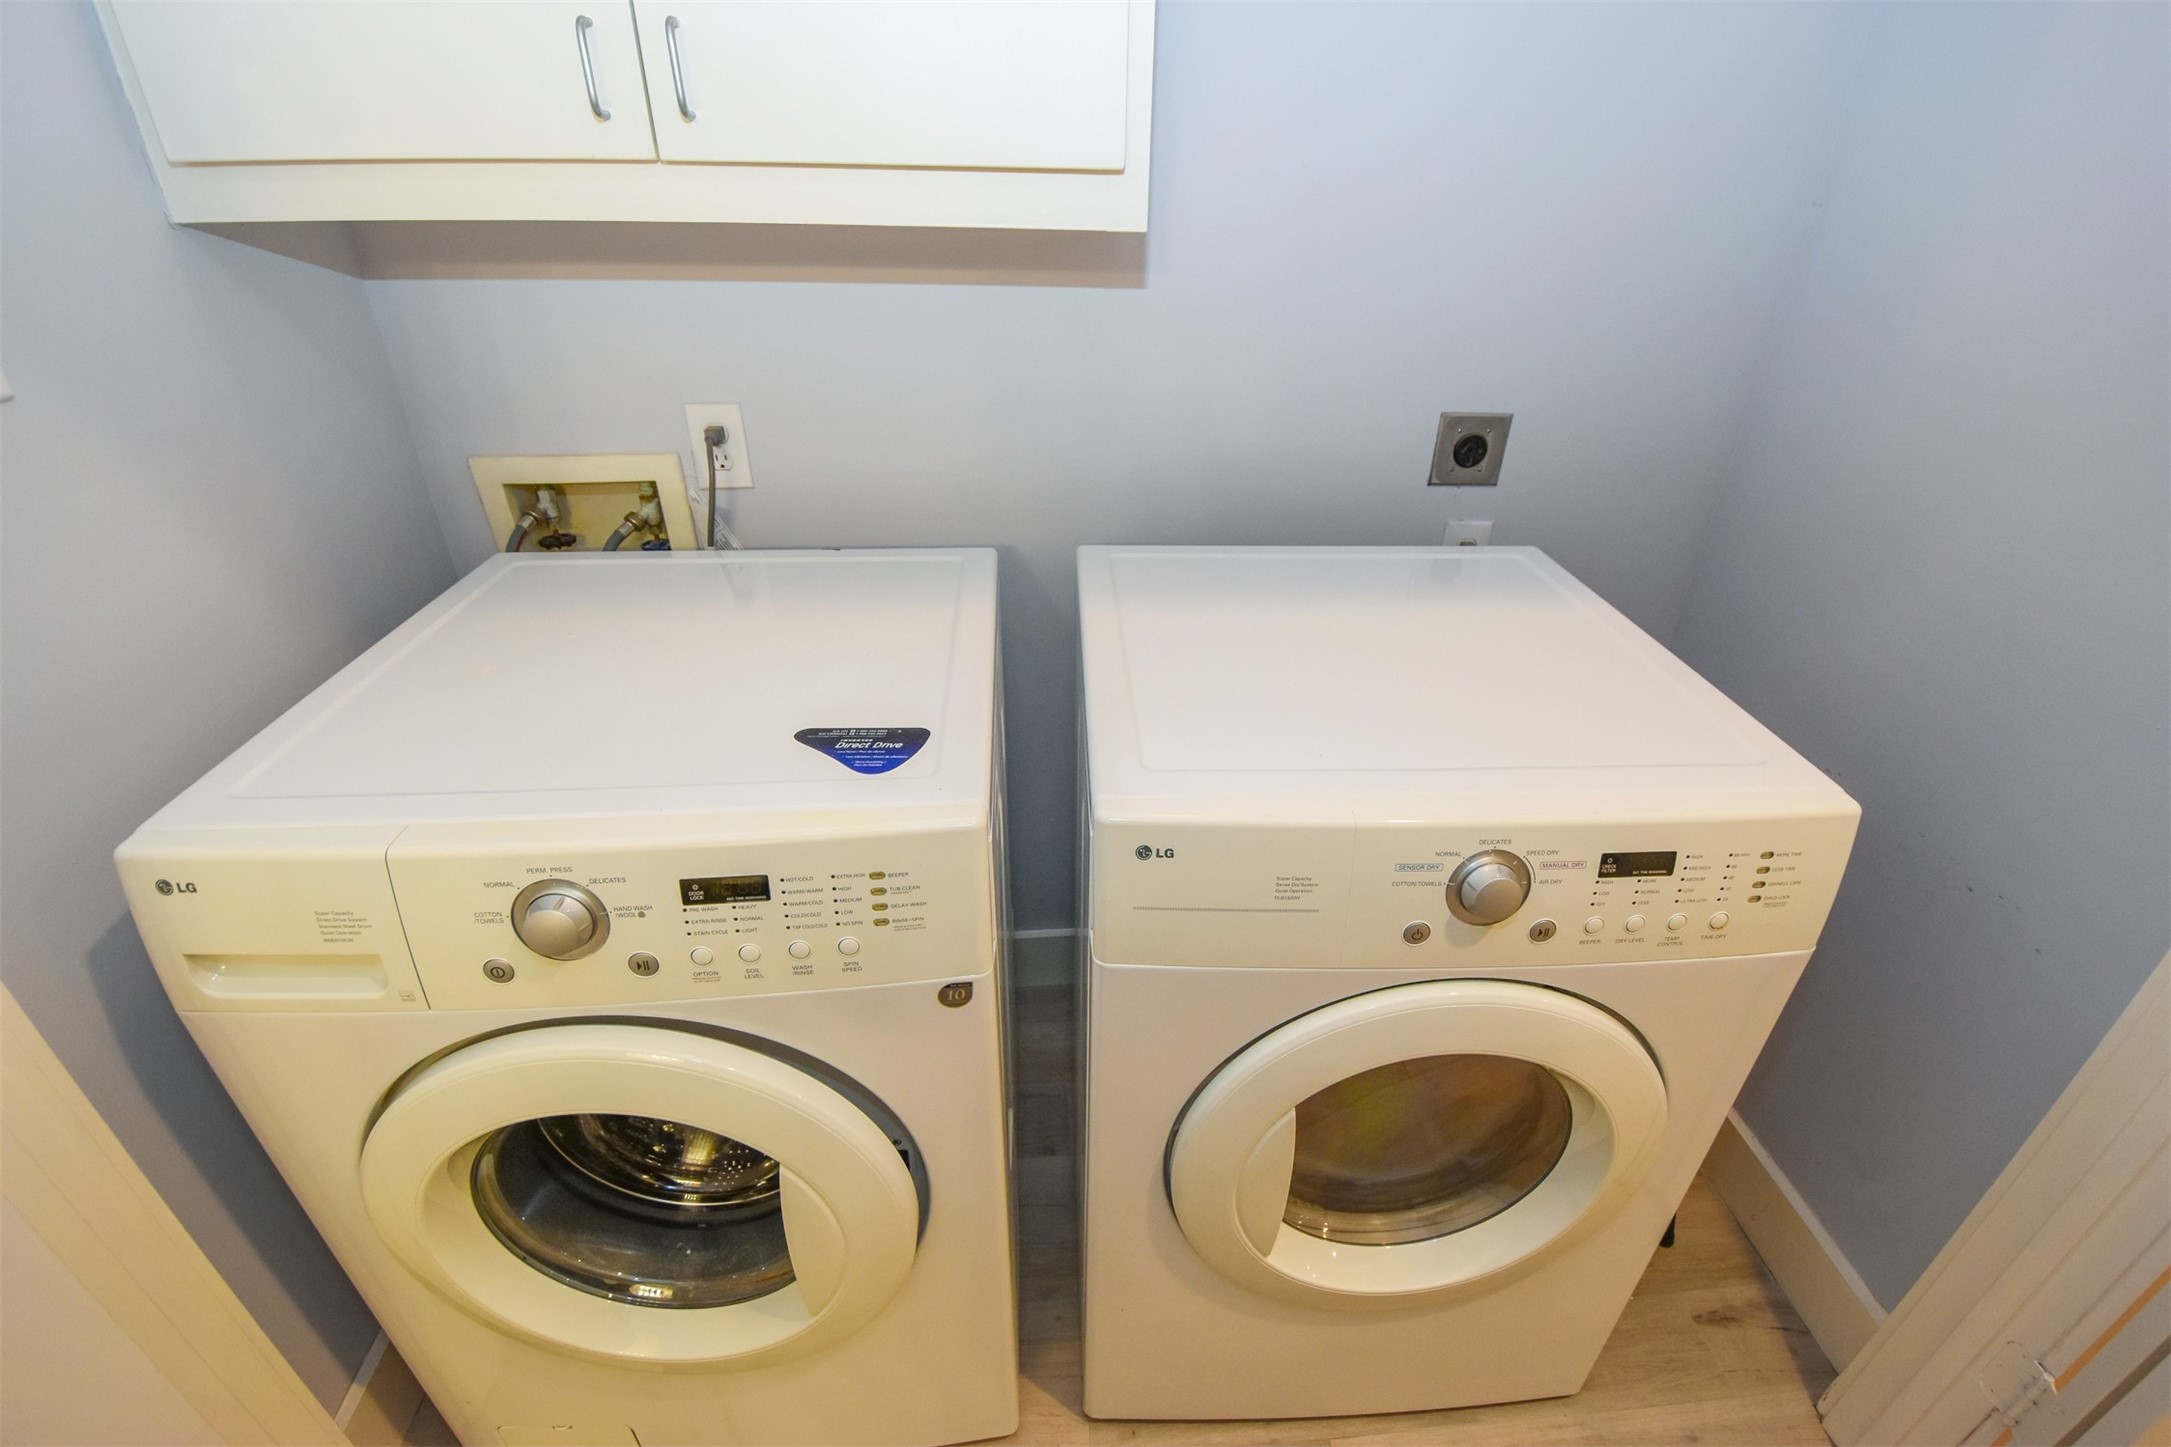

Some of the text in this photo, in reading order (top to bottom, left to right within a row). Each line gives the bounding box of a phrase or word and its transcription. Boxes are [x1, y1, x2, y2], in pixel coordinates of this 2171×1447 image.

[1156, 848, 1174, 858] LG
[589, 876, 626, 884] DELICATES
[176, 882, 197, 893] LG
[947, 989, 966, 1001] 10
